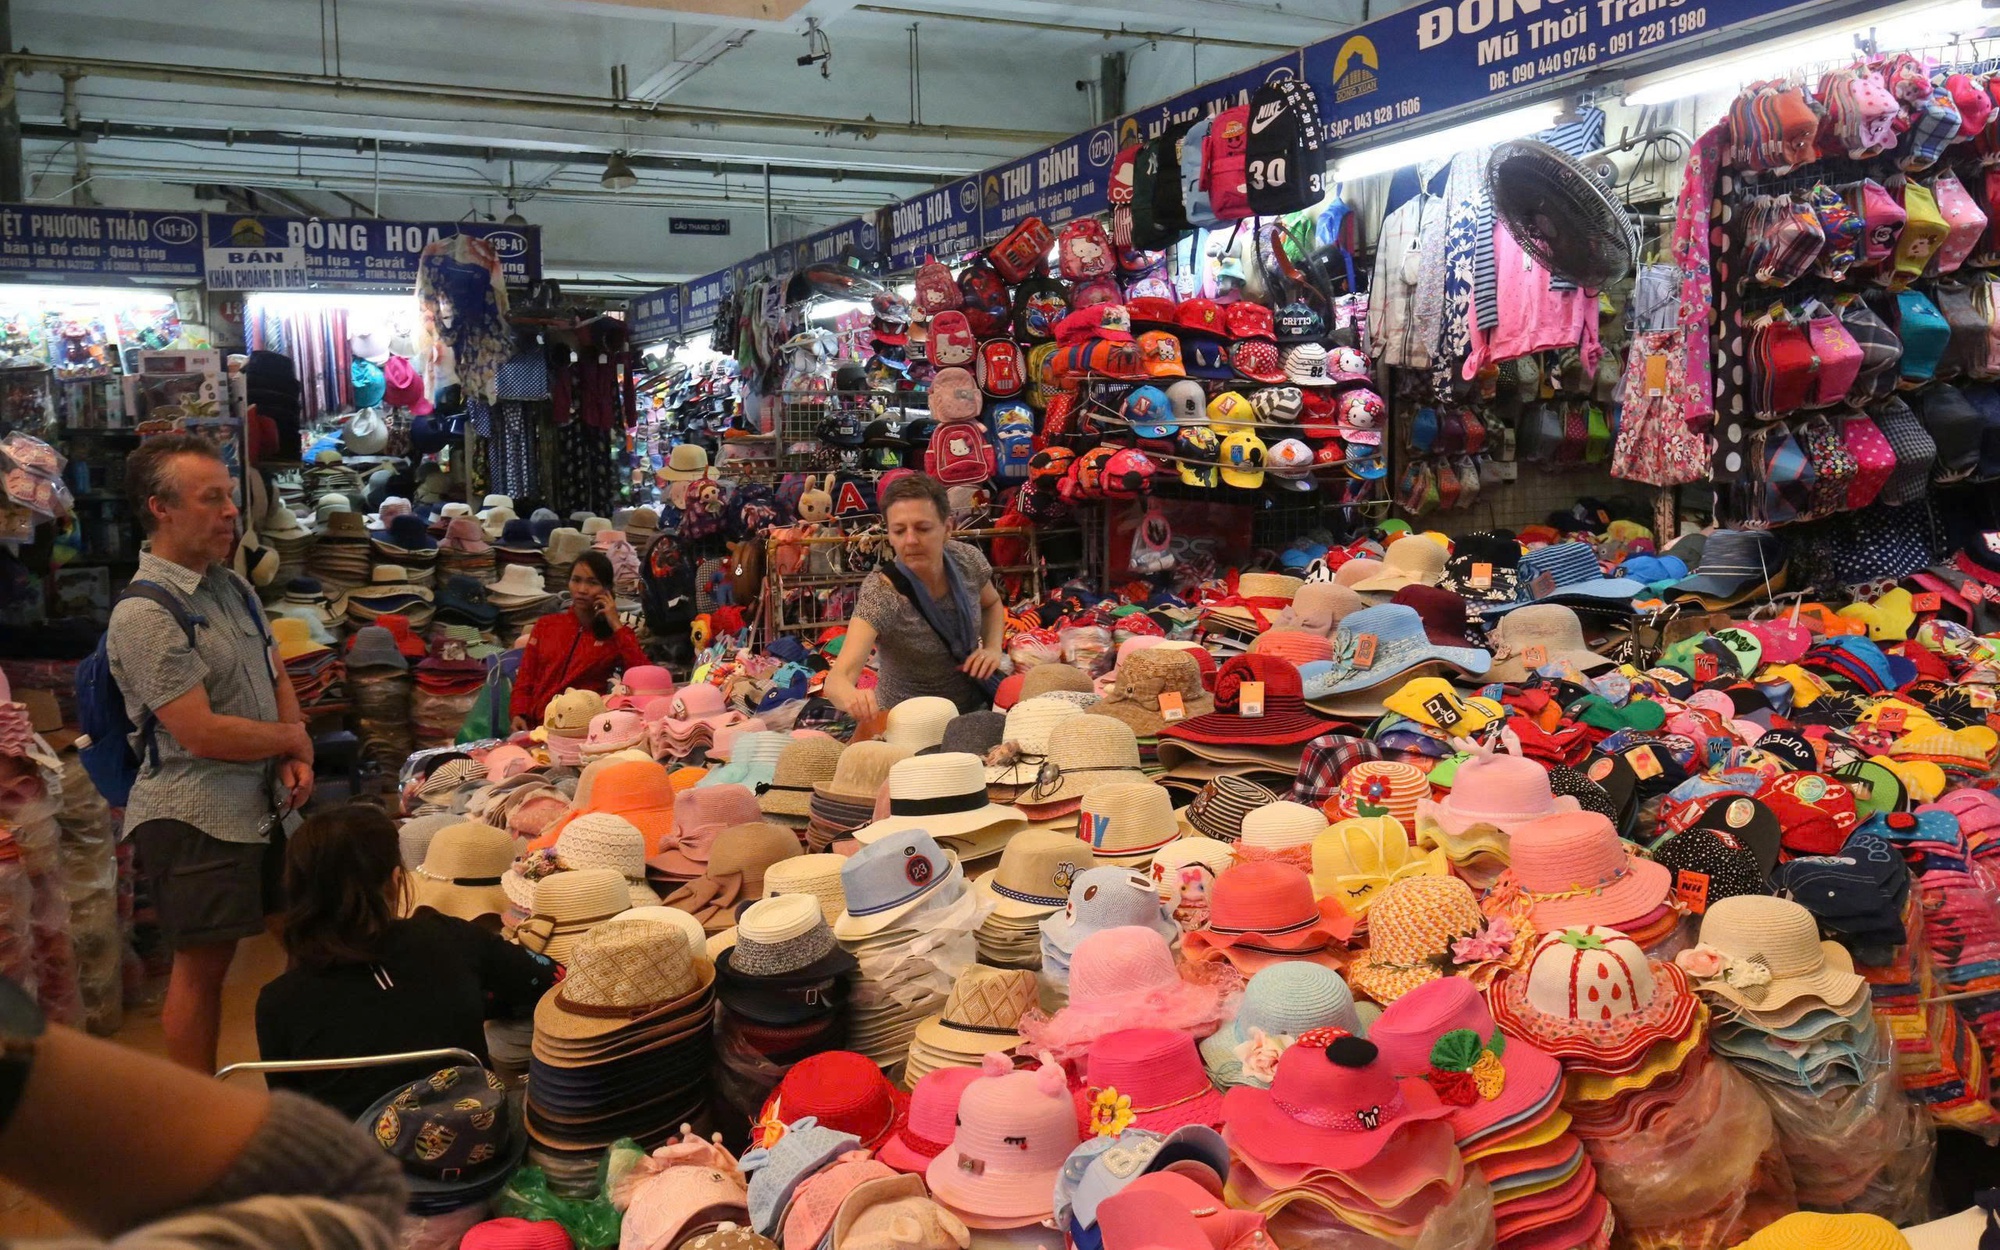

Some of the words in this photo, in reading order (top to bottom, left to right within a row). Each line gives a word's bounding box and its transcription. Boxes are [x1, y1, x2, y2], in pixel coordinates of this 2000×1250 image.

[1478, 29, 1519, 66] Mũ
[1527, 6, 1587, 49] Thời
[1490, 70, 1509, 91] DĐ:
[1512, 61, 1535, 84] 090
[1538, 53, 1562, 76] 440
[1563, 42, 1597, 69] 9746
[1609, 30, 1633, 55] 091
[1638, 20, 1665, 46] 228
[1669, 8, 1706, 36] 1980
[1256, 99, 1282, 120] NIKE
[1331, 118, 1352, 140] SẠP:
[1354, 111, 1372, 131] 043
[1374, 105, 1393, 126] 928
[1395, 96, 1420, 118] 1606
[1002, 163, 1032, 202] THU
[1249, 157, 1287, 190] 30
[1047, 191, 1062, 208] các
[1064, 184, 1080, 203] loại
[31, 213, 101, 239] PHƯƠNG
[106, 210, 149, 242] THẢO
[893, 201, 923, 239] ĐÔNG
[926, 190, 953, 227] HOA
[287, 216, 367, 251] ĐÔNG
[385, 226, 440, 253] HOA
[228, 250, 284, 264] BÁN
[327, 254, 350, 268] lụa
[501, 262, 525, 275] ưng
[235, 266, 272, 288] CHOÀNG
[835, 482, 869, 515] A
[1076, 812, 1110, 848] OY
[912, 863, 927, 880] 23
[1364, 1114, 1377, 1129] M
